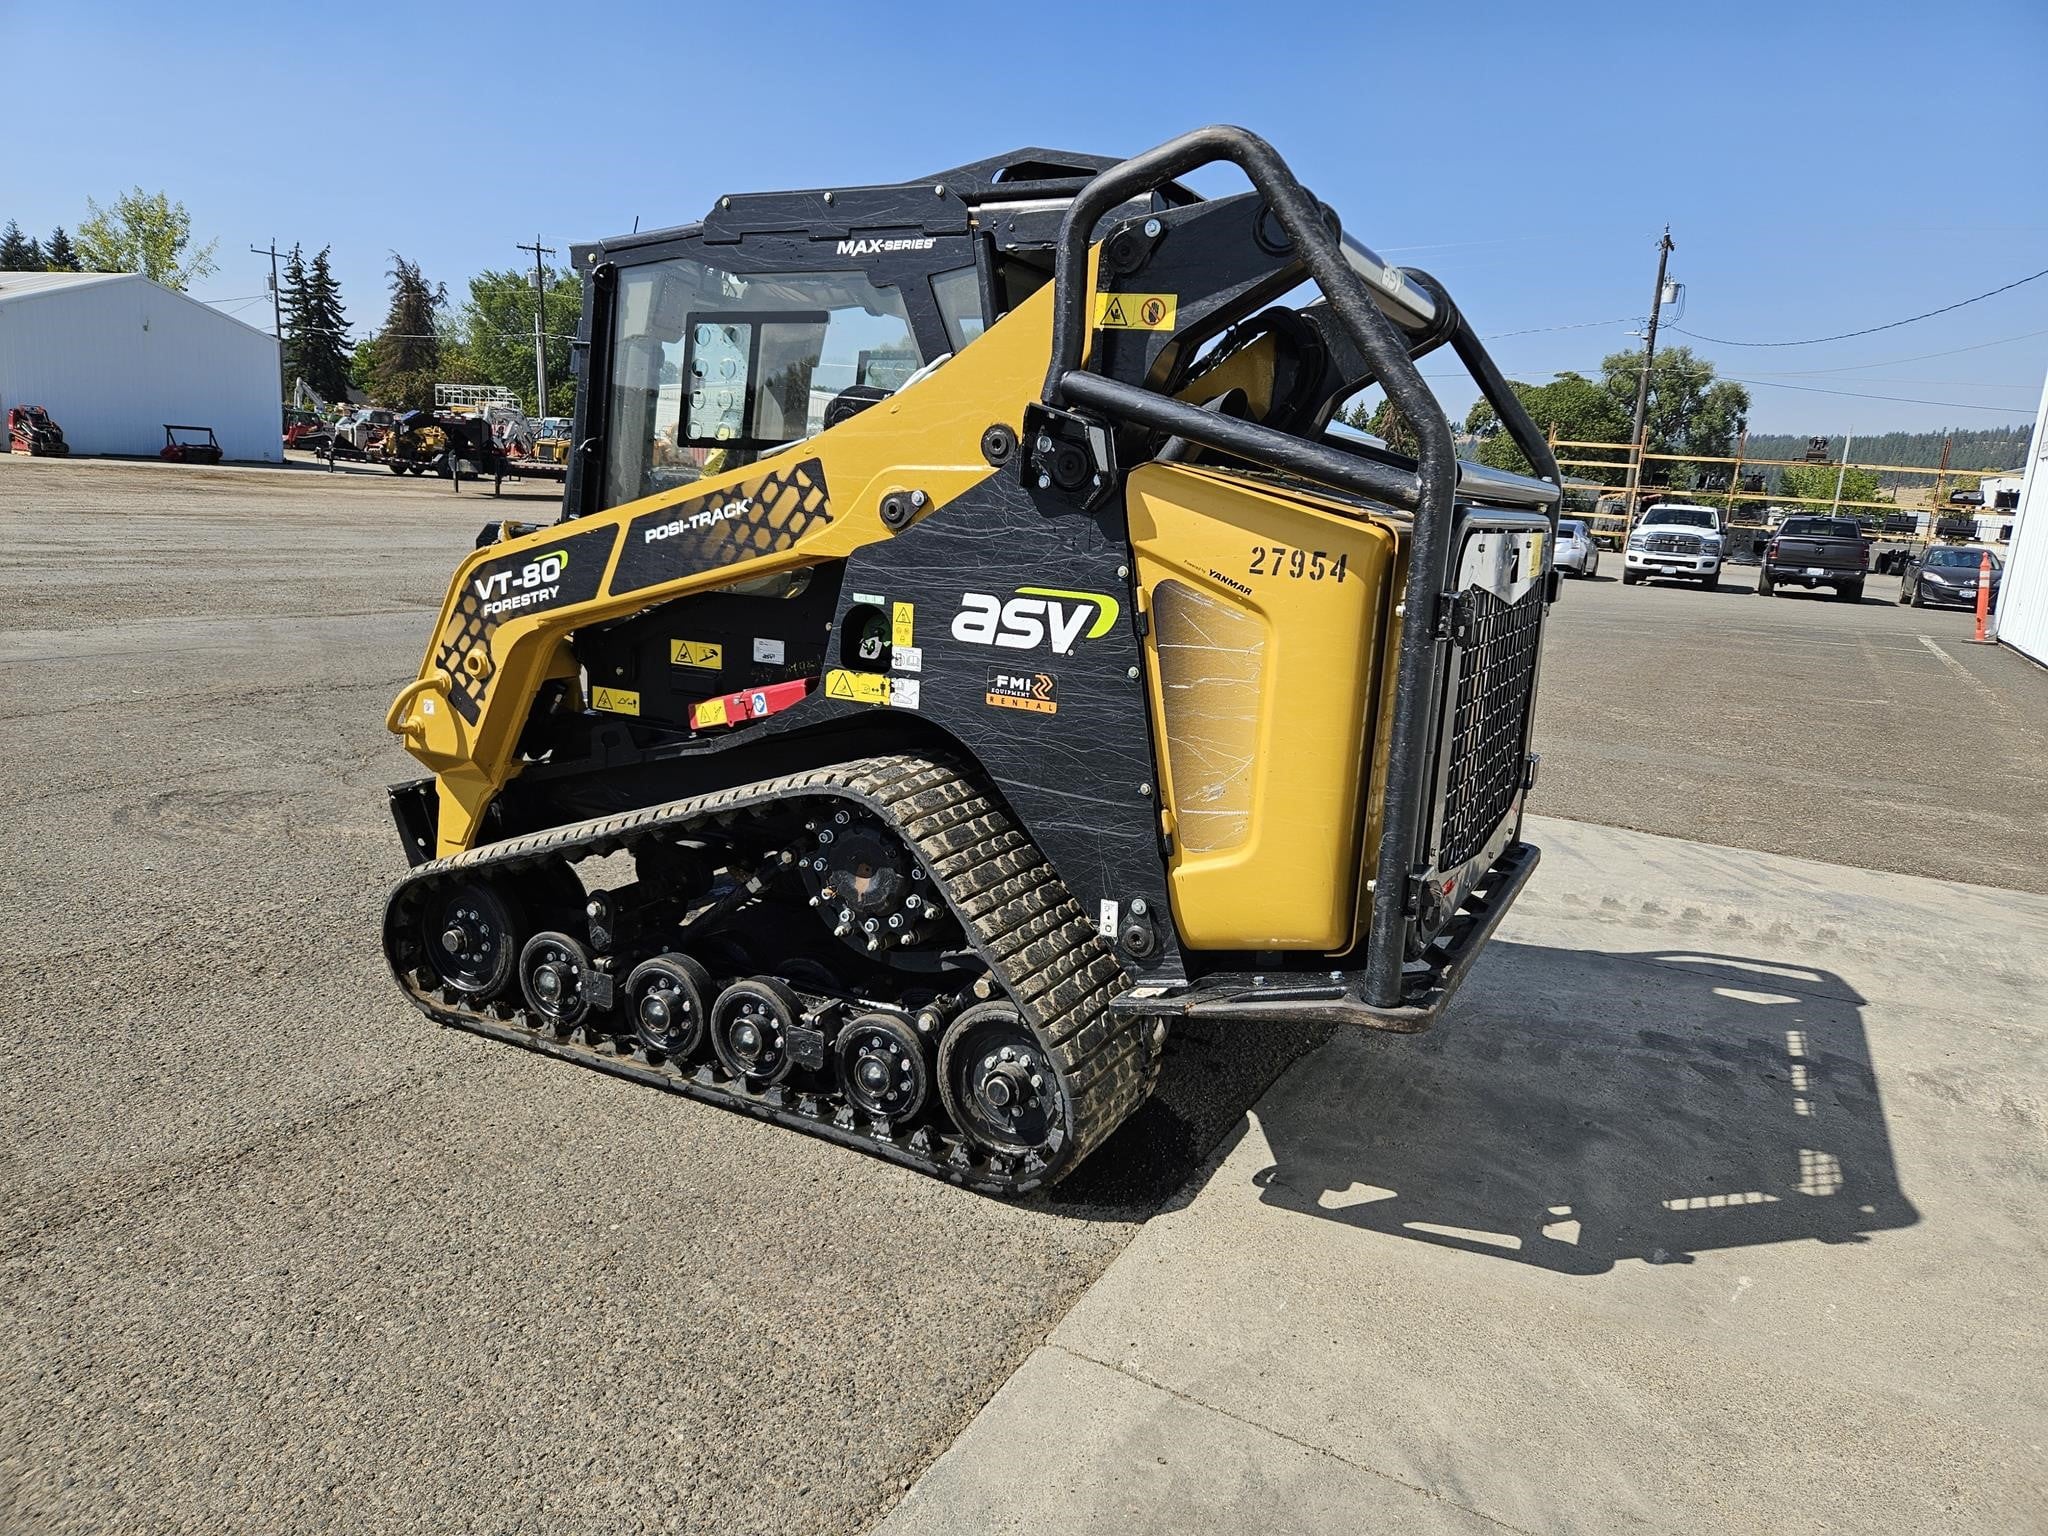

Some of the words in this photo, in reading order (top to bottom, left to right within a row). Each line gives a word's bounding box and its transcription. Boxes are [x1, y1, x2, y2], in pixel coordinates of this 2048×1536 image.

[836, 239, 934, 257] MAX-SERIES
[645, 498, 750, 544] POSI-TRACK
[1249, 546, 1348, 583] 27954
[474, 557, 561, 601] VT-80
[1208, 568, 1253, 596] YANMAR
[483, 585, 560, 617] FORESTRY
[991, 688, 1030, 697] EQUIPMENT
[997, 674, 1031, 691] FMI
[989, 696, 1053, 711] RENTAL
